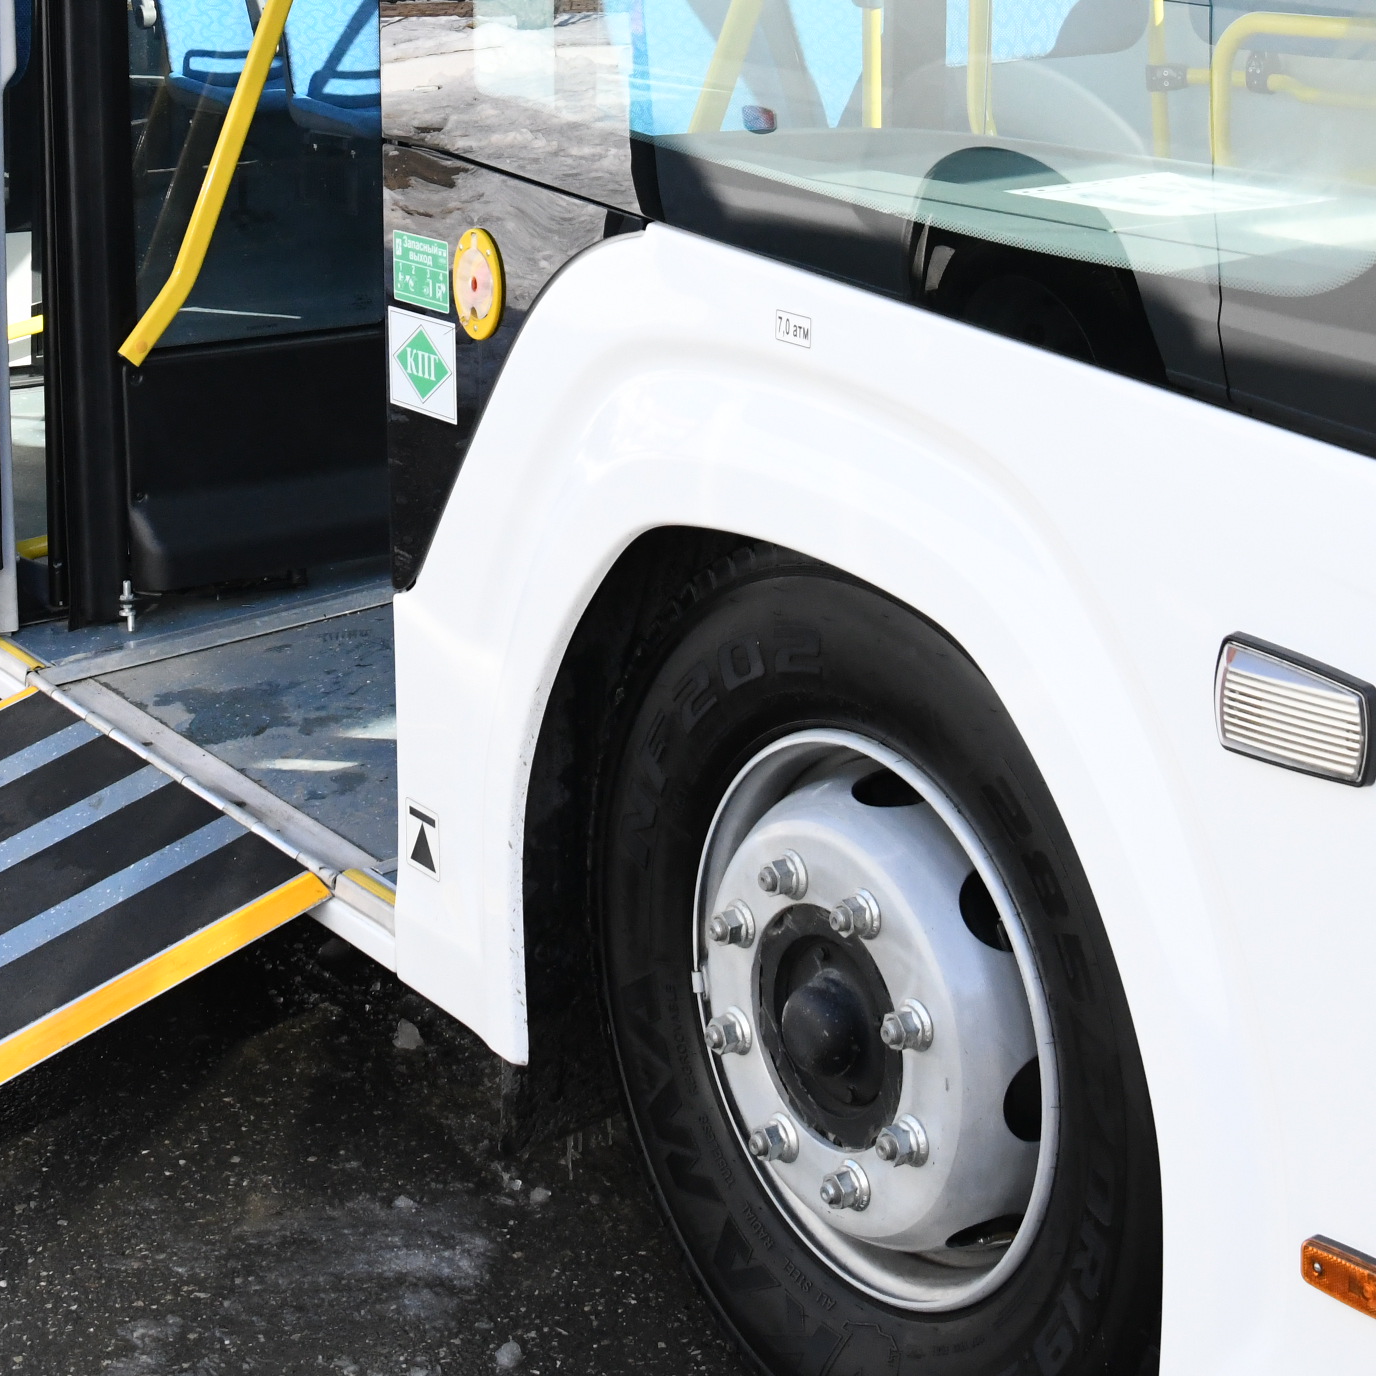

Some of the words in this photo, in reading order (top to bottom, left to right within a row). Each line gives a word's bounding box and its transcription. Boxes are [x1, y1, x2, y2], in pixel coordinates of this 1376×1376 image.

[402, 235, 439, 256] Запасный
[408, 251, 433, 267] выход
[777, 315, 791, 338] 7,0
[792, 324, 809, 341] атм
[405, 346, 439, 381] КПГ
[739, 1199, 775, 1251] RADIAL
[779, 1255, 814, 1295] STEEL
